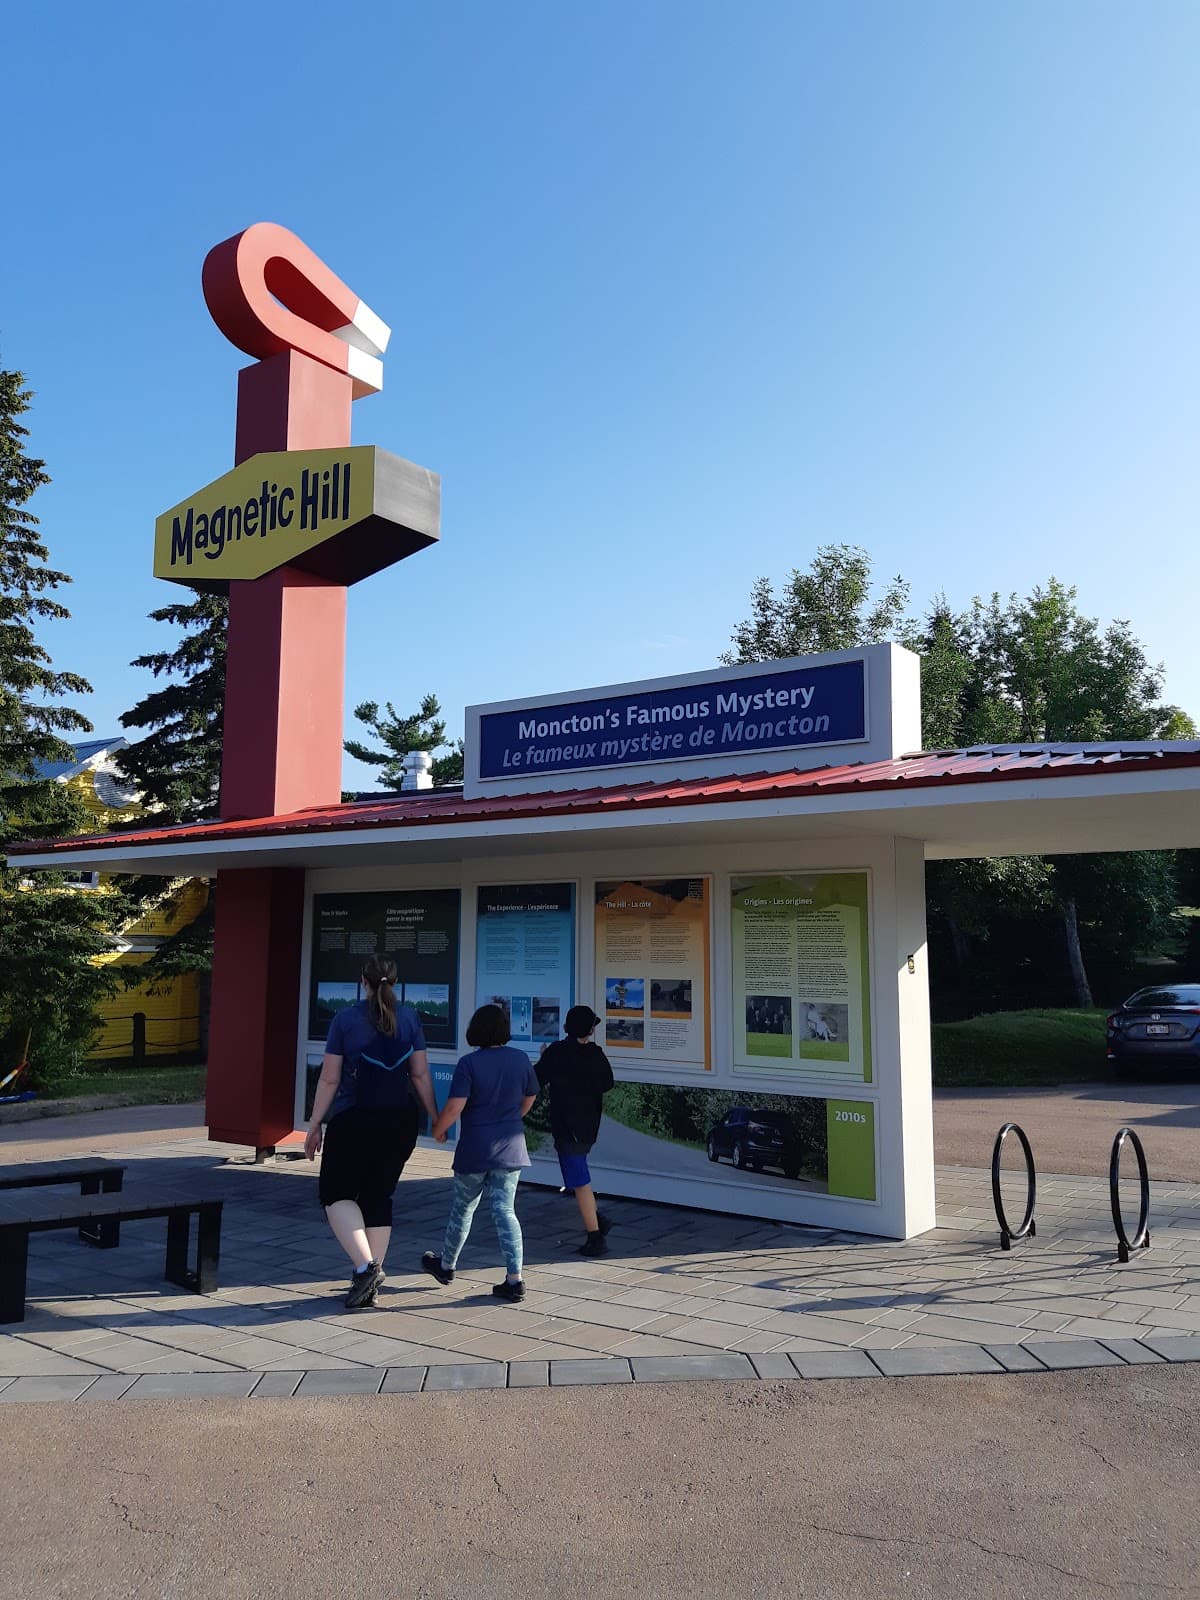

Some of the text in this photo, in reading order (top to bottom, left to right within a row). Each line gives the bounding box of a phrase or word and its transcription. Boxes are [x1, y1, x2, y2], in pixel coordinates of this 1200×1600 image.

[170, 463, 351, 566] Magnetic Hill
[518, 685, 815, 740] Moncton's Famous Mystery
[503, 712, 830, 768] Le fameux mystère de Moncton
[487, 904, 496, 912] The
[496, 903, 524, 912] Experience
[617, 900, 627, 909] Hill
[744, 897, 768, 907] Origins
[785, 896, 813, 906] origines
[835, 1110, 867, 1123] 2010s
